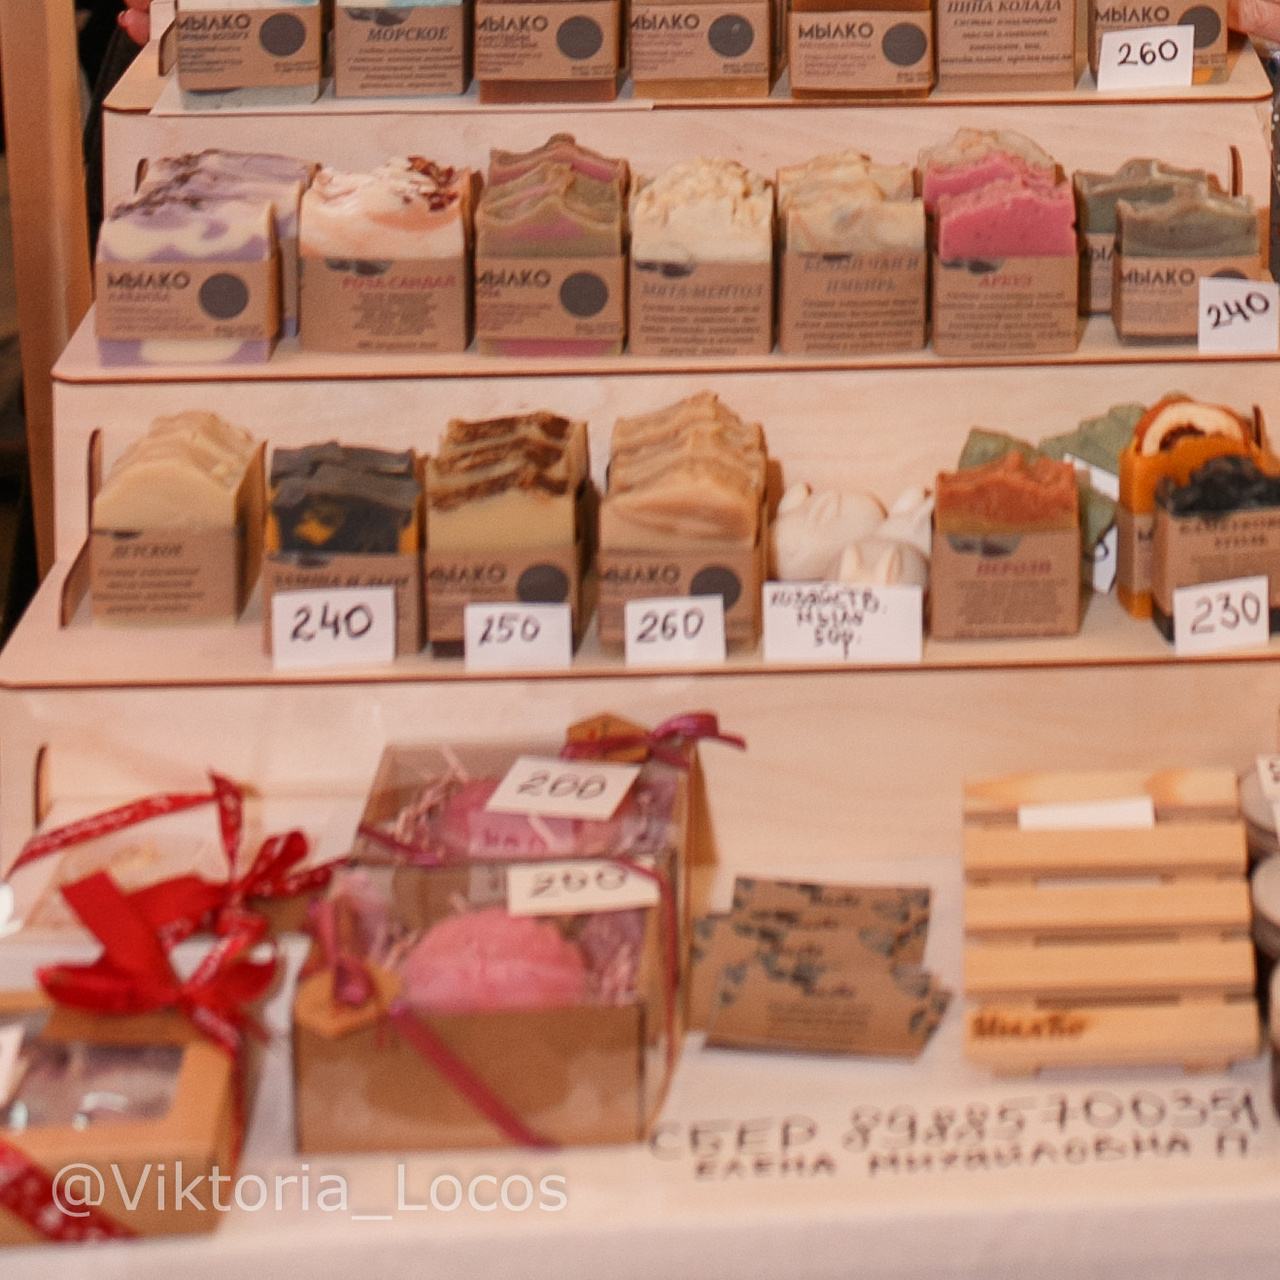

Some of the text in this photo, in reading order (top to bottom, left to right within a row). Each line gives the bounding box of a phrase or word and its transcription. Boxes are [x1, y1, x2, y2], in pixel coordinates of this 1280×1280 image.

[798, 22, 874, 40] МЫЛКО
[1095, 5, 1170, 23] МЫЛКО
[1117, 39, 1178, 66] 260
[1207, 291, 1270, 330] 240
[290, 602, 373, 642] 240
[635, 606, 704, 643] 260
[1190, 591, 1261, 635] 230
[516, 769, 608, 801] 200
